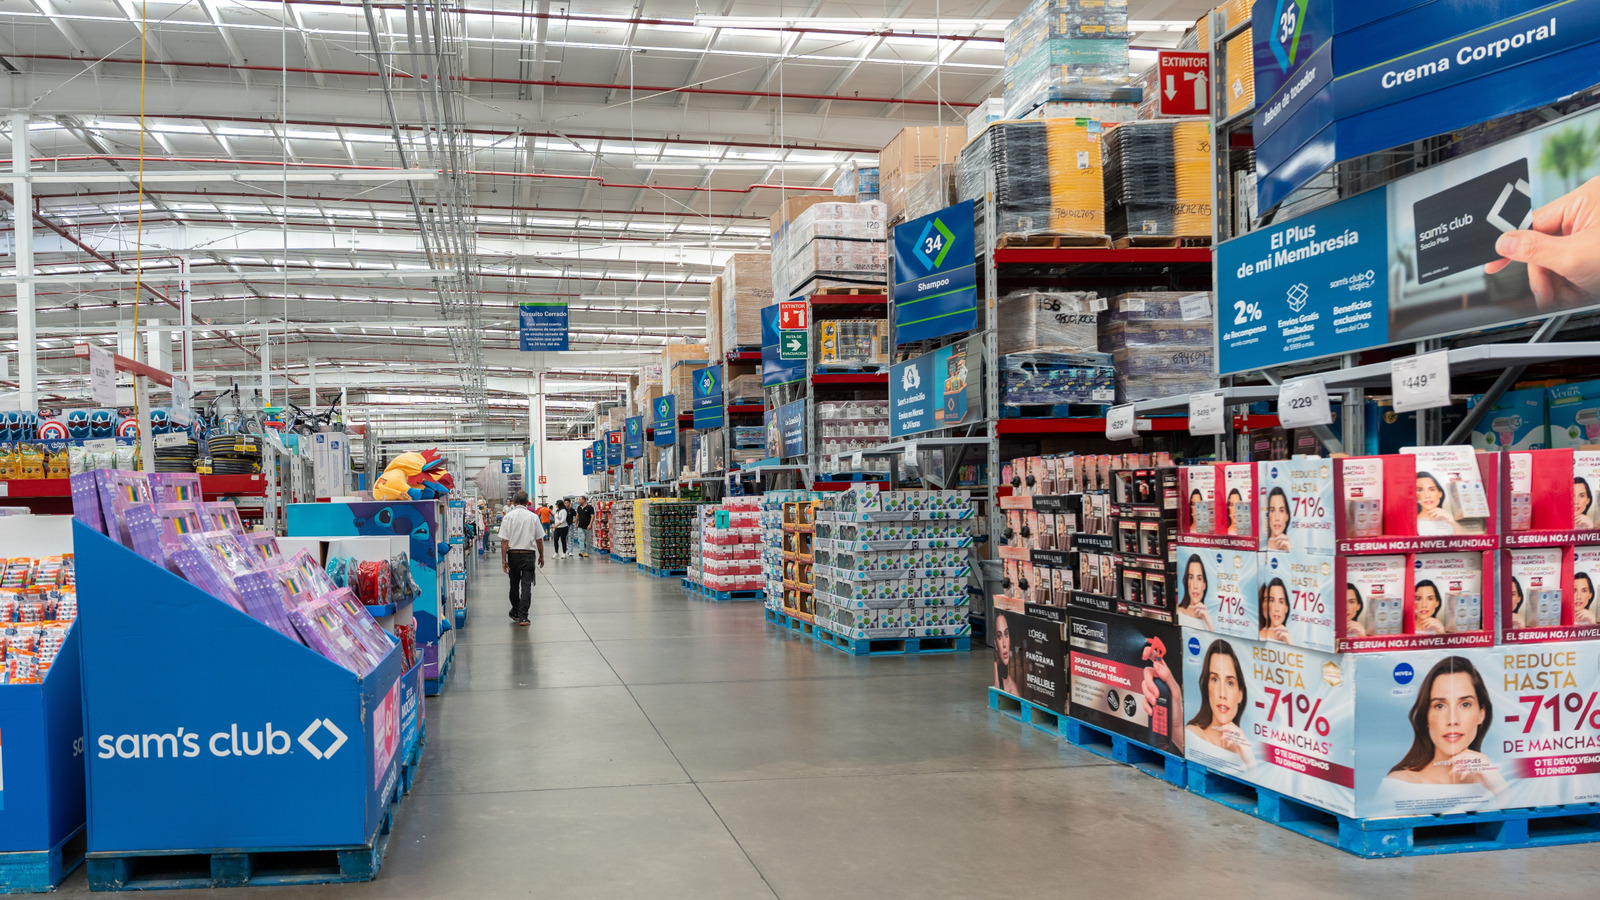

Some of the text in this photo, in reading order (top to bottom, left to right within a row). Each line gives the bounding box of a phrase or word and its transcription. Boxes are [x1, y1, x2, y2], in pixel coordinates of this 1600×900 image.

[1280, 3, 1296, 43] 35
[1381, 17, 1557, 89] Crema Corporal
[1162, 56, 1208, 68] EXTINTOR
[1263, 67, 1316, 126] Jabón de tocador
[1419, 213, 1473, 242] sam's club
[925, 234, 942, 254] 34
[1271, 224, 1316, 250] El Plus
[1420, 236, 1450, 251] Socio Plus
[1237, 228, 1359, 279] de mi Membresía
[917, 278, 950, 292] Shampoo
[1348, 280, 1370, 292] viajes
[1349, 273, 1365, 284] club
[1233, 300, 1263, 326] 2%
[1333, 300, 1372, 316] Beneficios
[1278, 316, 1299, 329] Envíos
[1333, 311, 1372, 327] exclusivos
[1356, 321, 1370, 331] Club
[1223, 325, 1267, 341] de Recompensa
[703, 378, 711, 388] 30
[1551, 388, 1581, 399] Venus
[1288, 396, 1312, 409] $229
[1291, 470, 1317, 479] REDUCE
[1291, 482, 1319, 493] HASTA
[1292, 497, 1325, 518] 71%
[1291, 521, 1300, 529] DE
[1077, 537, 1112, 546] MAYBELLINE
[1177, 535, 1184, 543] EL
[1214, 538, 1230, 546] NIVEL
[1340, 539, 1448, 551] EL SERUM NO.1 A NIVEL
[1505, 536, 1517, 544] EL
[1517, 534, 1548, 543] SERUM
[1549, 534, 1569, 542] NO.1
[1291, 563, 1318, 574] REDUCE
[1216, 572, 1240, 582] REDUCE
[1291, 577, 1319, 588] HASTA
[1216, 583, 1240, 594] HASTA
[1075, 595, 1109, 608] MAYBELLINE
[1217, 595, 1245, 616] 71%
[1291, 590, 1325, 614] 71%
[1029, 607, 1059, 618] MAYBELLINE
[1291, 614, 1299, 622] DE
[1072, 623, 1104, 638] TRESemmé
[1506, 633, 1517, 641] EL
[1518, 631, 1548, 640] SERUM
[1550, 630, 1569, 638] NO.1
[1340, 638, 1445, 650] EL SERUM NO.1 A NIVEL
[1025, 651, 1054, 667] PANORAMA
[1074, 657, 1091, 666] 2PACK
[1091, 661, 1108, 671] SPRAY
[1252, 646, 1304, 669] REDUCE
[1504, 651, 1576, 670] REDUCE
[1074, 665, 1131, 686] PROTECCIÓN TÉRMICA
[1253, 663, 1305, 690] HASTA
[1504, 671, 1578, 692] HASTA
[1255, 686, 1330, 737] -71%
[1504, 692, 1600, 734] -71%
[1254, 723, 1268, 738] DE
[98, 722, 292, 759] sam's club
[1503, 739, 1524, 754] DE
[1274, 756, 1306, 772] TU DINERO
[1288, 751, 1330, 771] DEVOLVEMOS
[1534, 766, 1577, 776] TU DINERO
